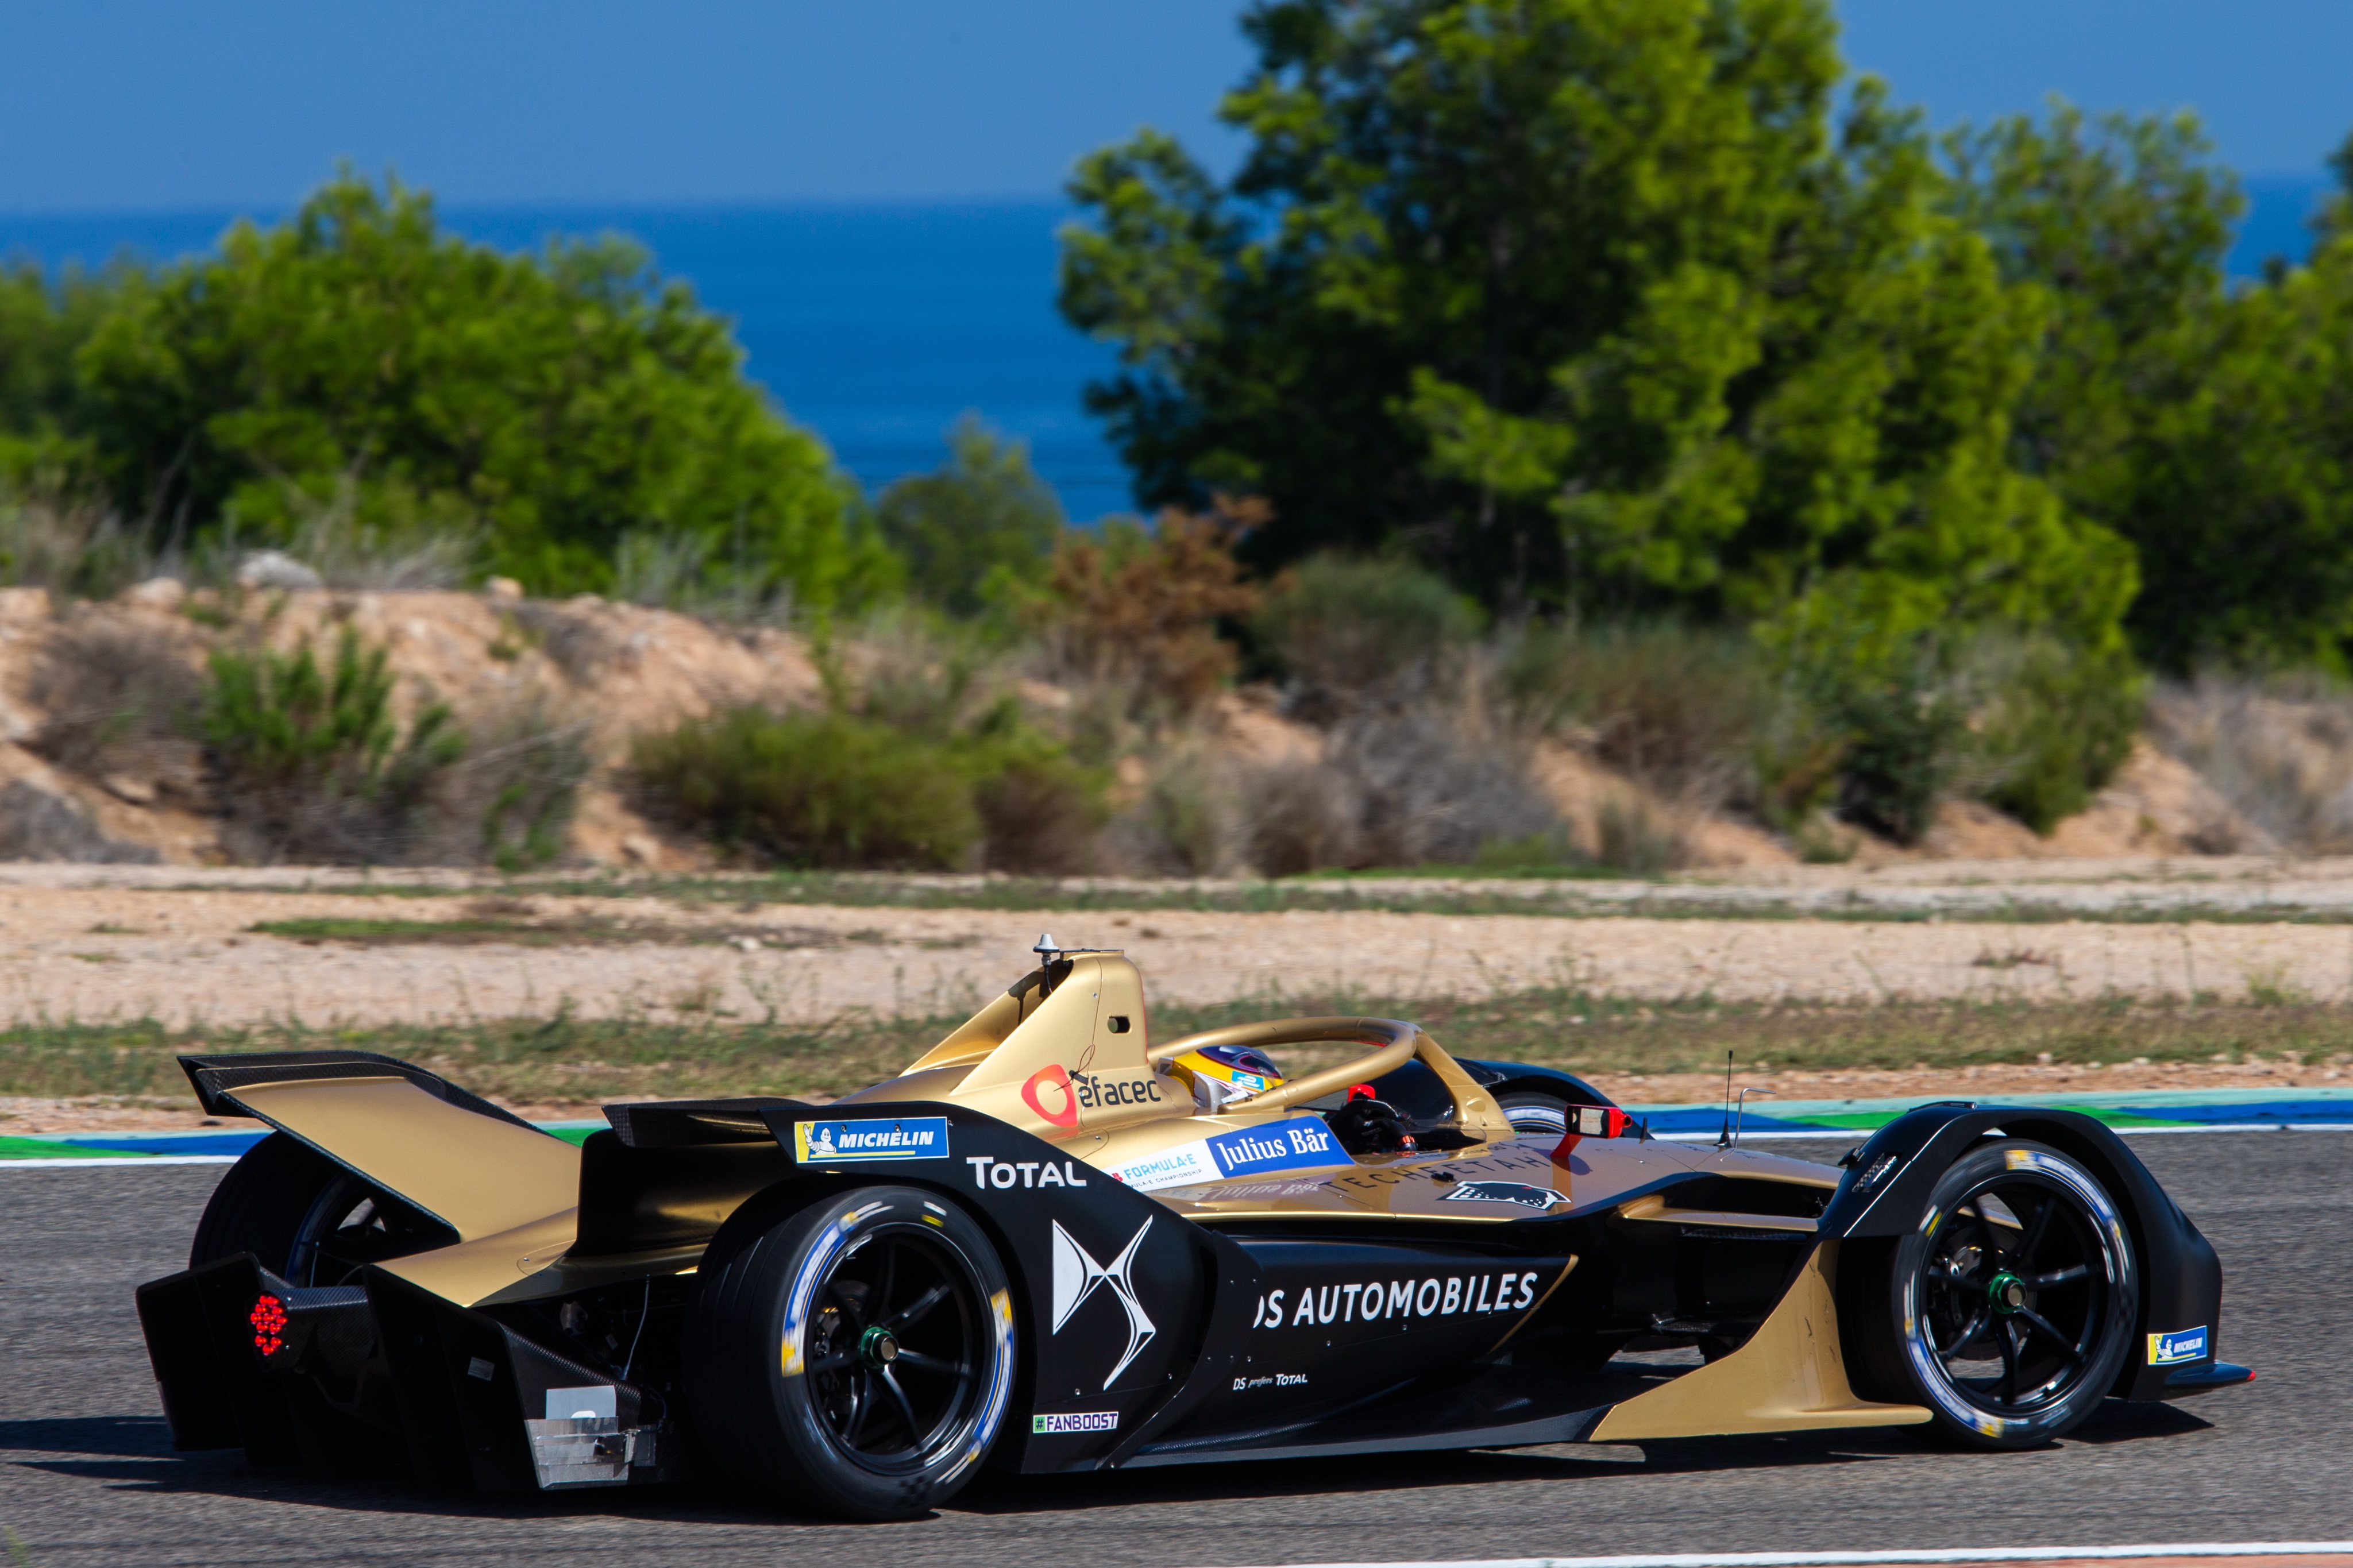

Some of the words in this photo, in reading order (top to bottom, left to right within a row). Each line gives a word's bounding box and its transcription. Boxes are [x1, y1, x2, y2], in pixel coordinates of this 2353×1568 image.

[1078, 1076, 1161, 1107] efacec
[838, 1131, 934, 1148] MICHELIN
[1217, 1137, 1287, 1171] Julius
[1287, 1128, 1330, 1155] Bär
[966, 1156, 1087, 1189] TOTAL
[1155, 1169, 1202, 1183] CHAMPIONSHIP
[1321, 1156, 1551, 1193] TECHEETAH
[1293, 1272, 1538, 1326] AUTOMOBILES
[2173, 1337, 2203, 1354] MICHELIN
[1233, 1377, 1247, 1391] DS
[1276, 1373, 1308, 1386] TOTAL
[1036, 1413, 1117, 1431] #FANBOOST
